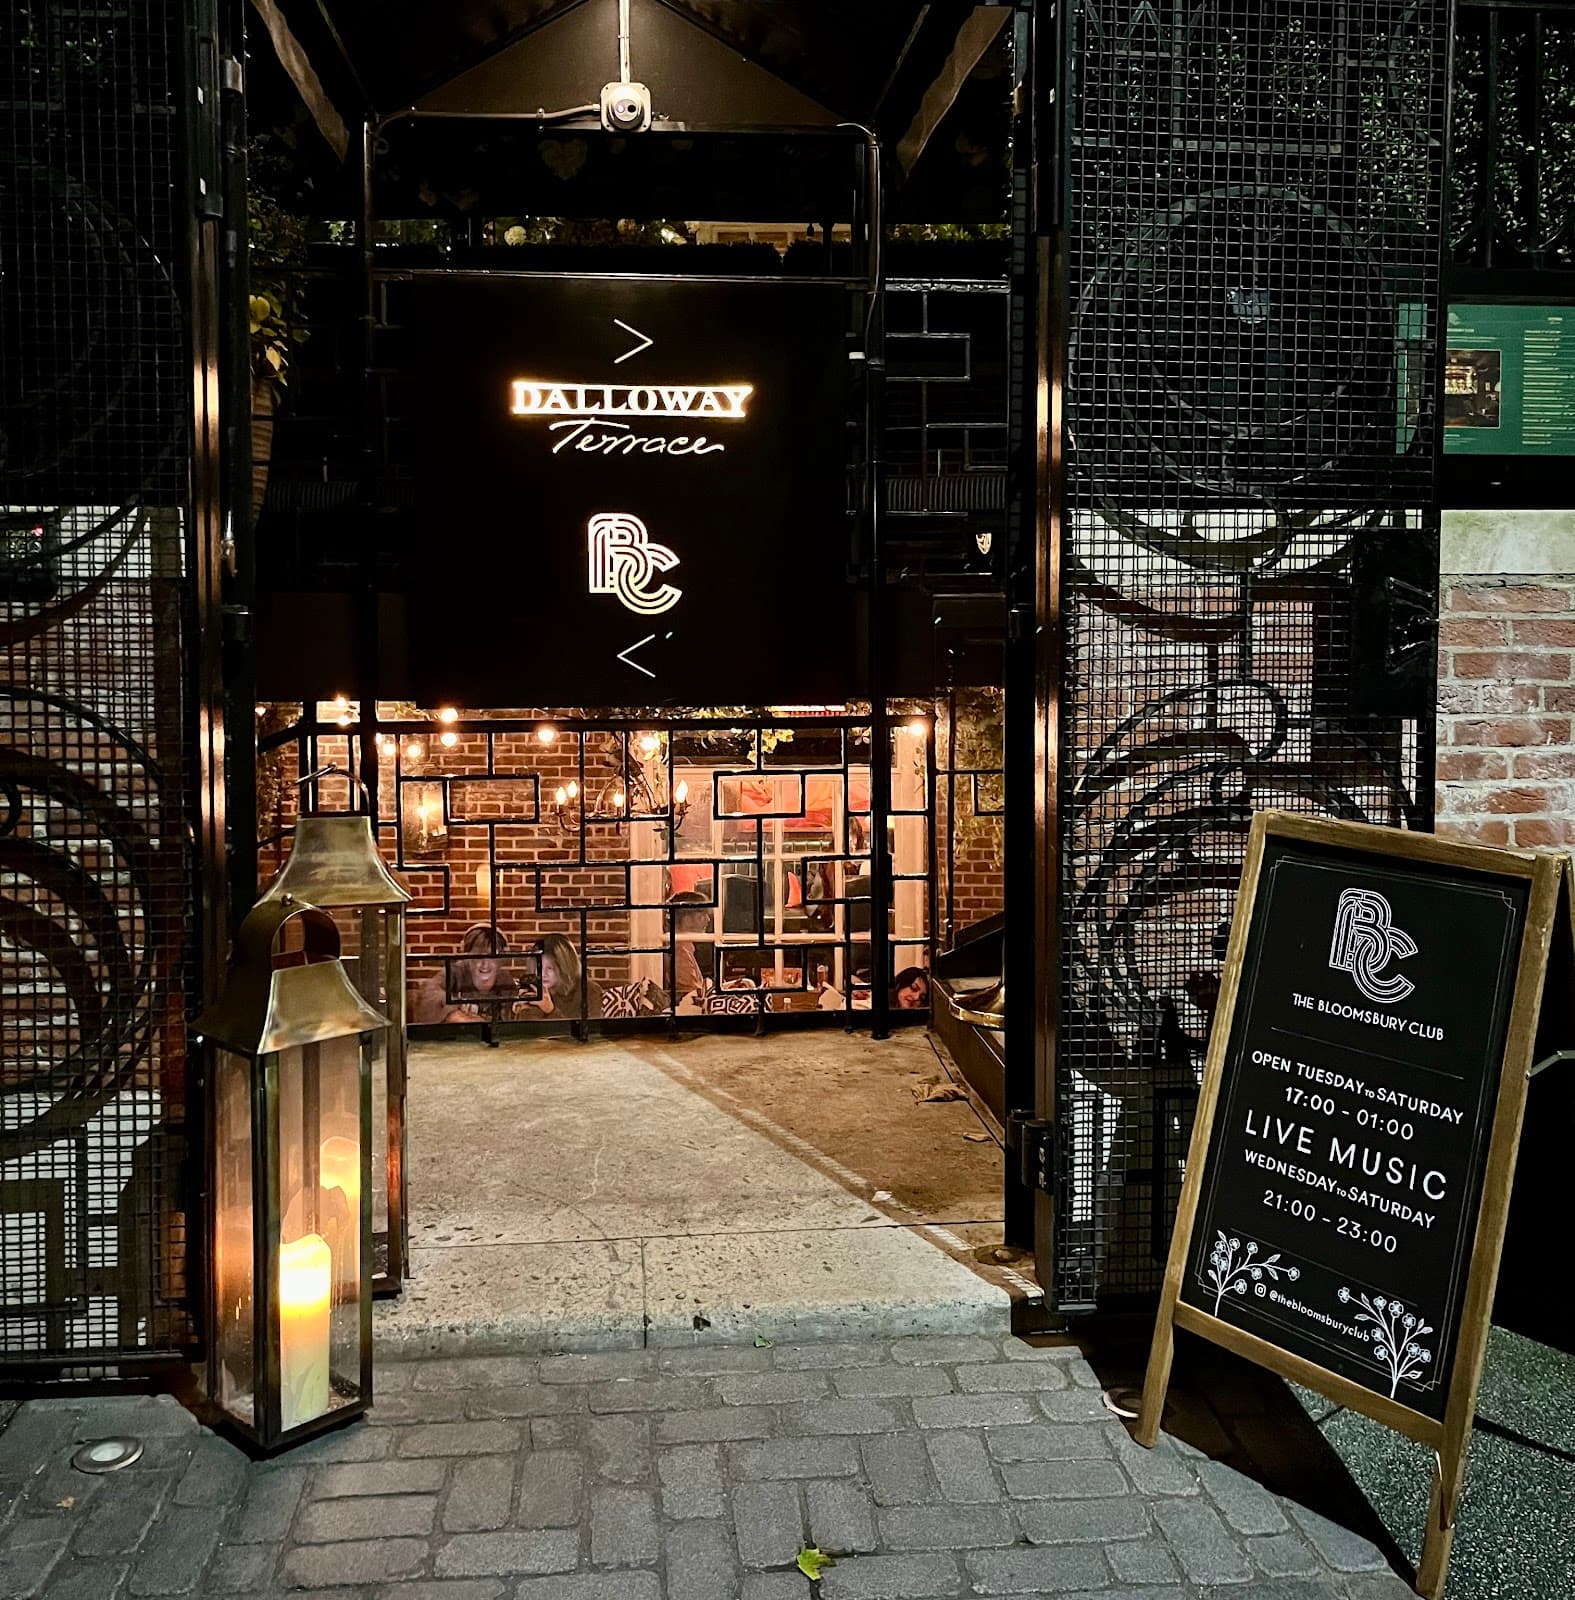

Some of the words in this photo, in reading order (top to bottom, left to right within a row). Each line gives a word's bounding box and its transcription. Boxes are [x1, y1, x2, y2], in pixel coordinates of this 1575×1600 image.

[511, 381, 753, 417] DALLOWAY
[549, 417, 725, 455] Terrace
[1292, 992, 1315, 1010] THE
[1317, 999, 1408, 1033] BLOOMSBURY
[1408, 1021, 1445, 1042] CLUB
[1251, 1050, 1291, 1073] OPEN
[1296, 1062, 1365, 1094] TUESDAY
[1376, 1087, 1465, 1126] SATURDAY
[1284, 1086, 1336, 1116] 17:00
[1356, 1108, 1415, 1141] 01:00
[1244, 1109, 1315, 1155] LIVE
[1328, 1136, 1448, 1201] MUSIC
[1244, 1148, 1338, 1194] WEDNESDAY
[1347, 1186, 1437, 1230] SATURDAY
[1262, 1189, 1317, 1223] 21:00
[1336, 1216, 1398, 1254] 23:00
[1268, 1289, 1371, 1343] @thebloomsburyclub
